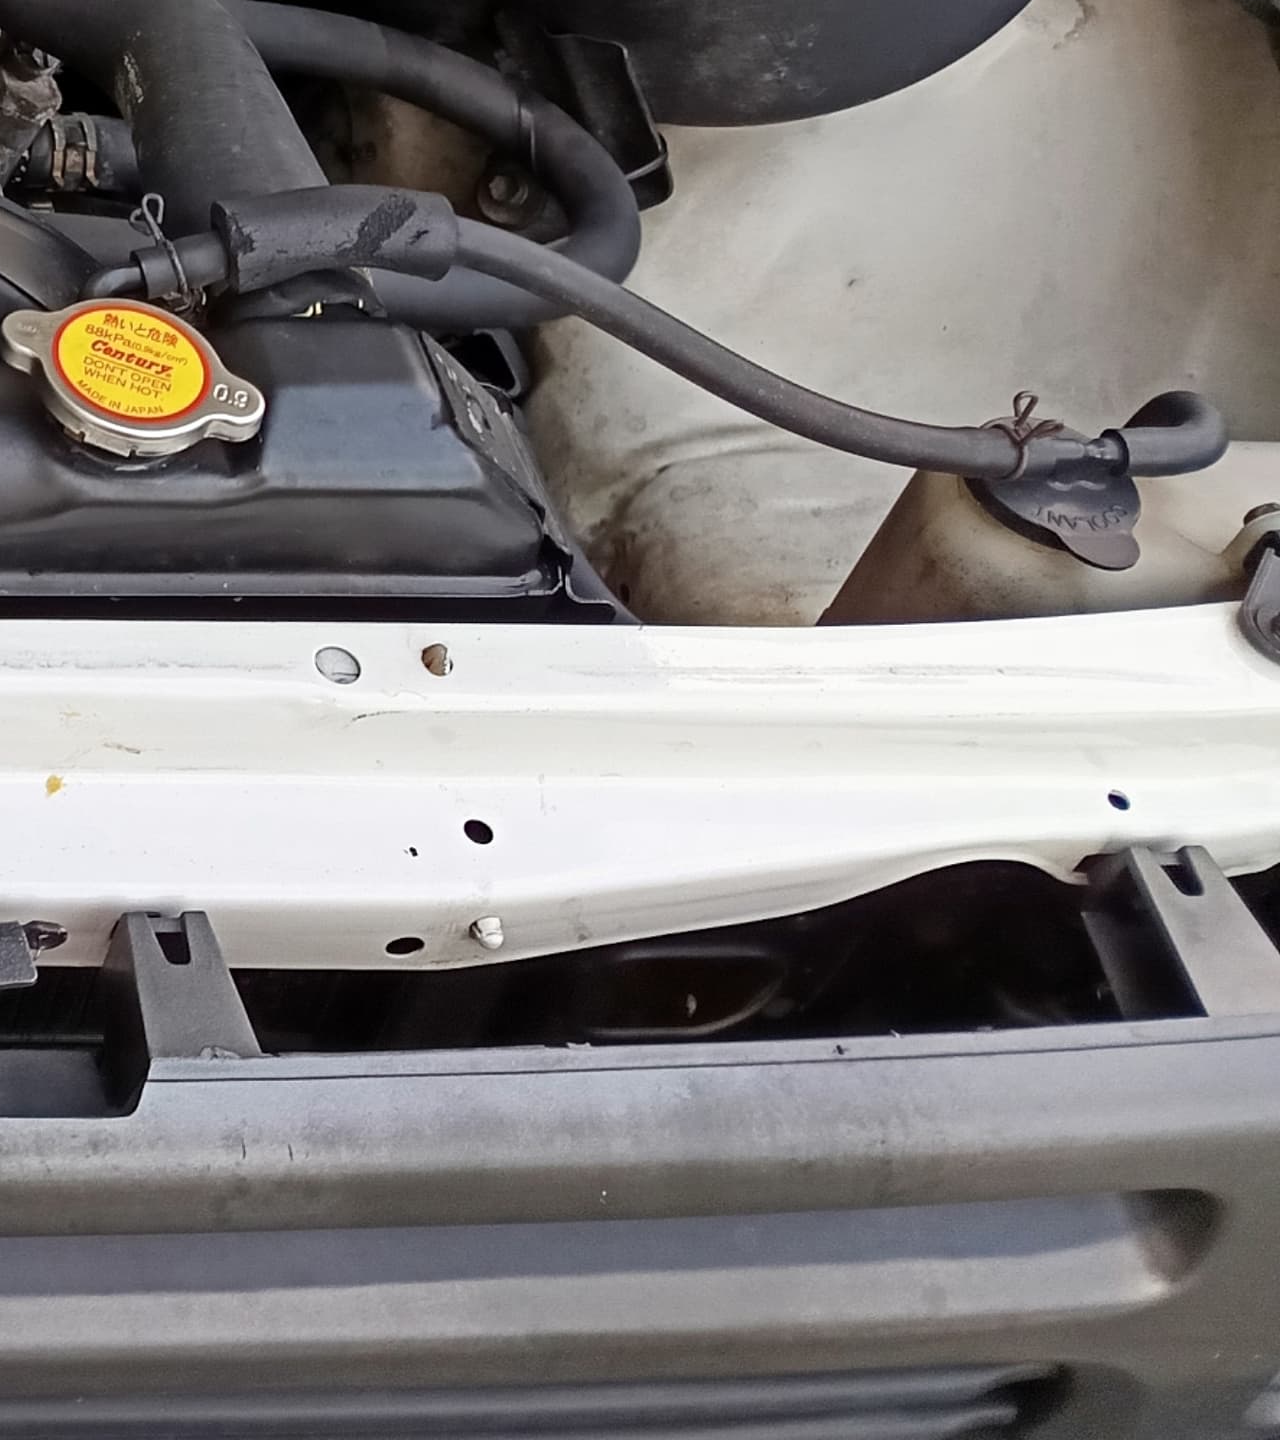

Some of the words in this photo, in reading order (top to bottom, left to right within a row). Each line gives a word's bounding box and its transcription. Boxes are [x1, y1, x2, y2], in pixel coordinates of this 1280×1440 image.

[103, 313, 179, 348] 熱いと危険
[91, 339, 173, 375] Century
[84, 366, 127, 388] WHEN
[130, 372, 172, 393] OPEN
[76, 379, 108, 402] MADE
[108, 398, 122, 410] IN
[125, 404, 164, 415] JAPAN
